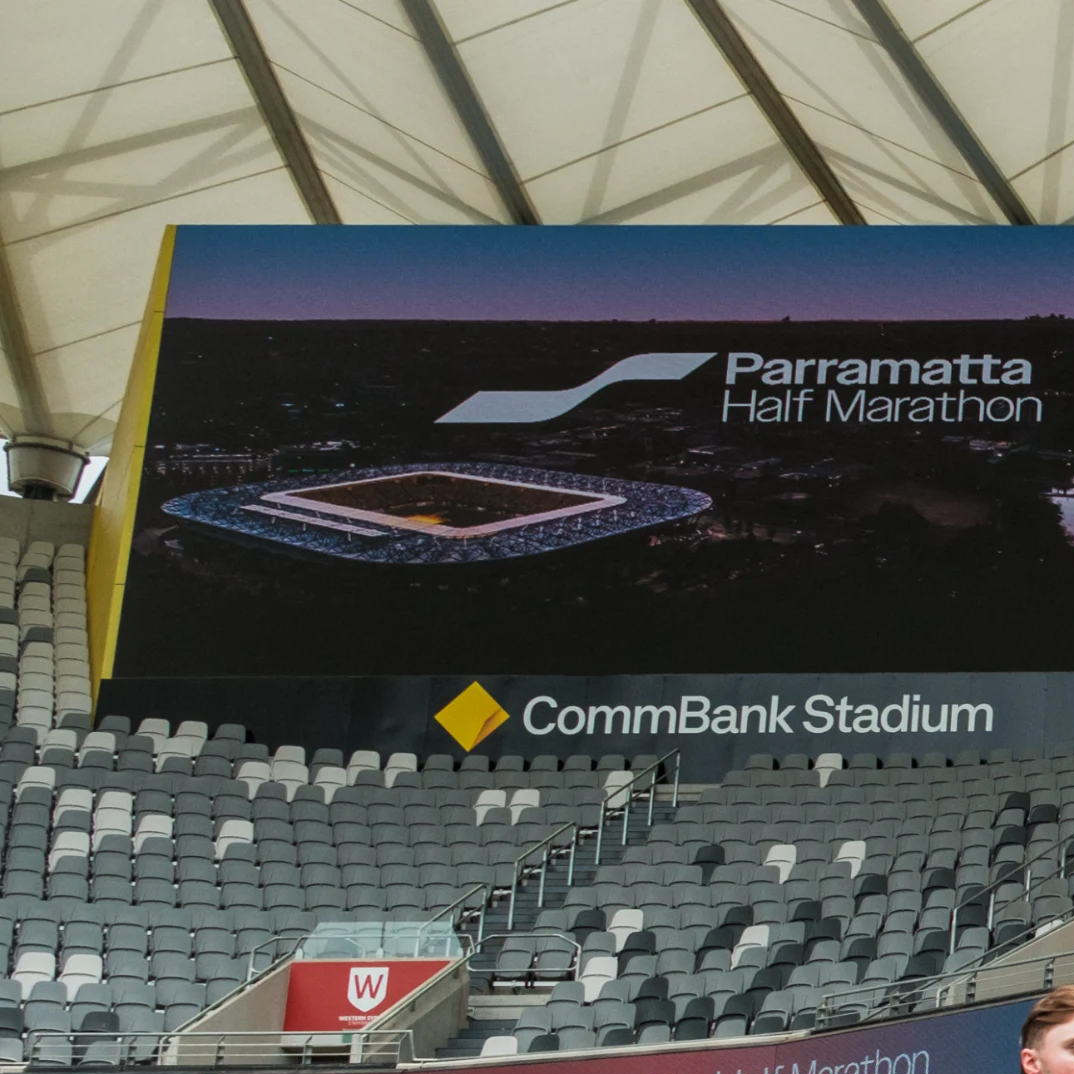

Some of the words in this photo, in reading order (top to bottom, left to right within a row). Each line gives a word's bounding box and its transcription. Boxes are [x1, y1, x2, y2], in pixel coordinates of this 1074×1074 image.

[725, 352, 1032, 386] Parramatta
[722, 388, 814, 423] Half
[825, 388, 1043, 423] Marathon
[523, 694, 796, 736] CommBank
[802, 694, 994, 734] Stadium
[354, 974, 384, 999] W
